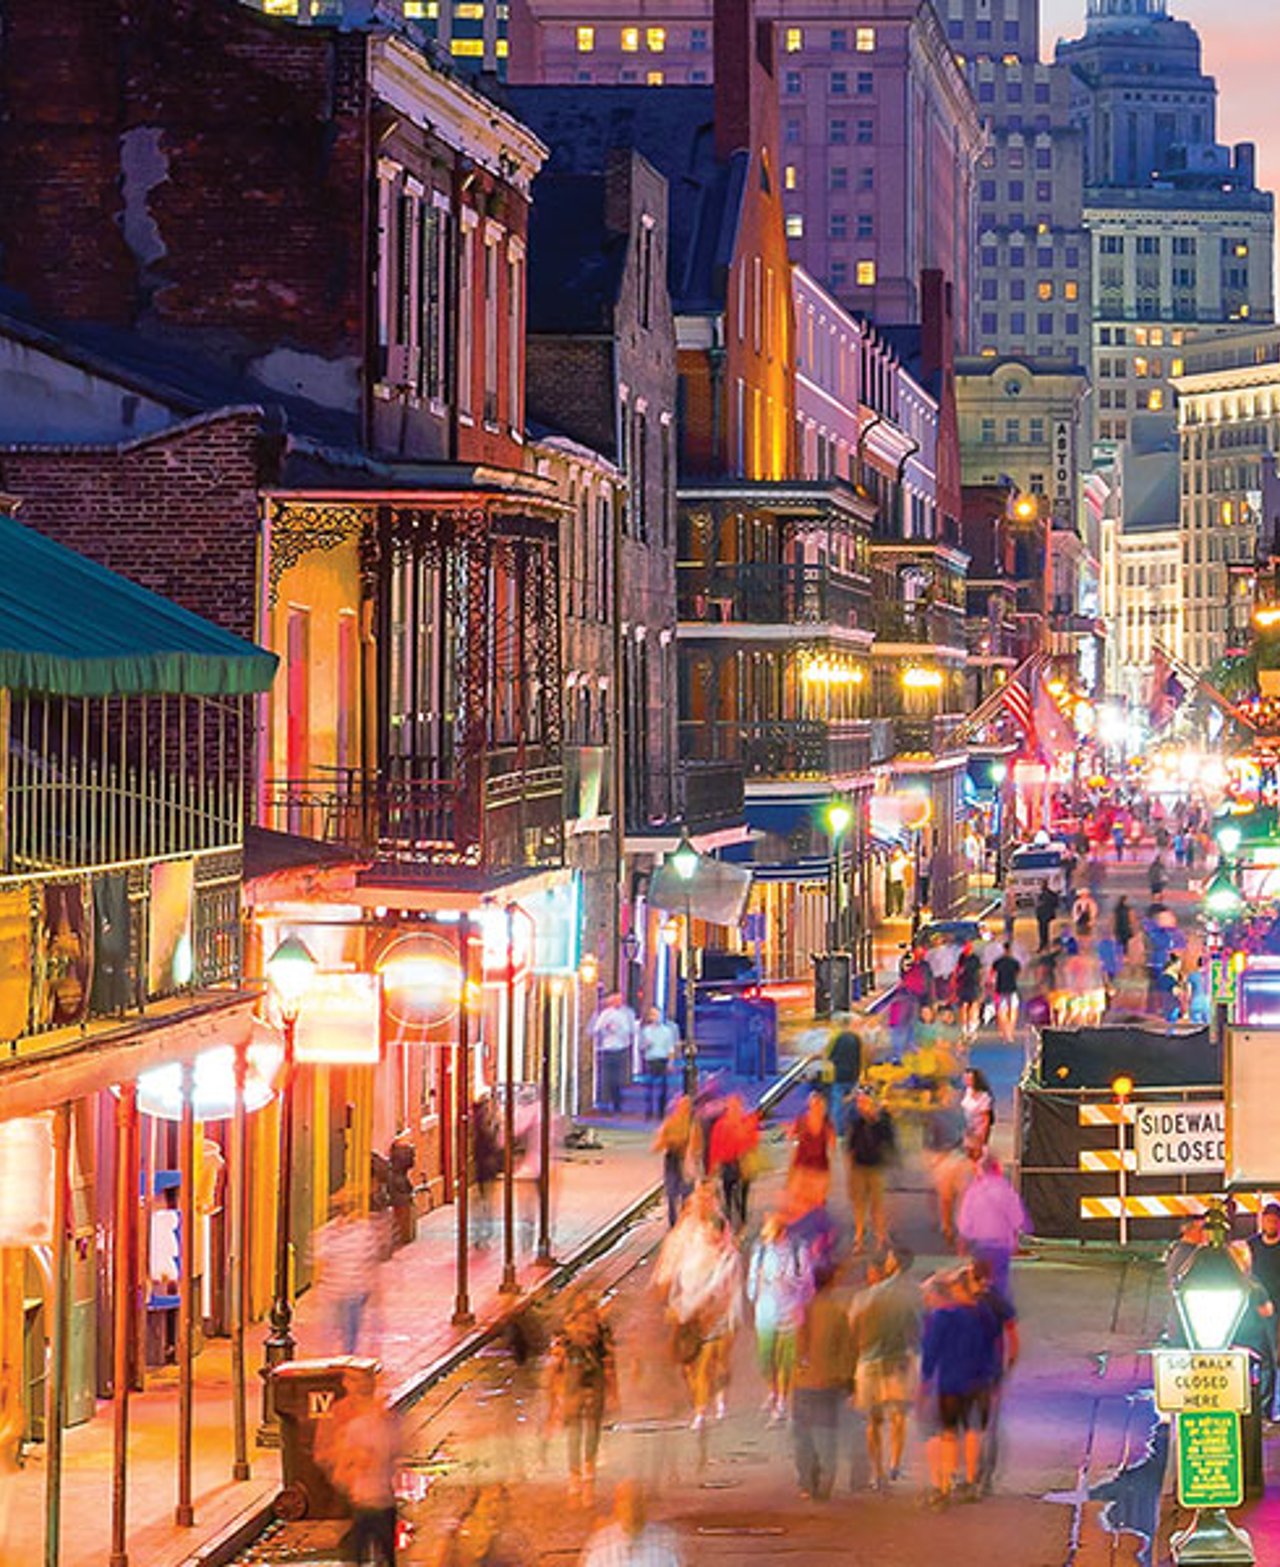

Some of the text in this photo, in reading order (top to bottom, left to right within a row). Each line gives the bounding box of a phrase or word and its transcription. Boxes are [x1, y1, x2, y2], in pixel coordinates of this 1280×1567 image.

[1056, 422, 1067, 498] ASTOR
[1141, 1112, 1225, 1136] SIDEWAL
[1174, 1375, 1229, 1390] CLOSED
[1183, 1393, 1220, 1408] HERE
